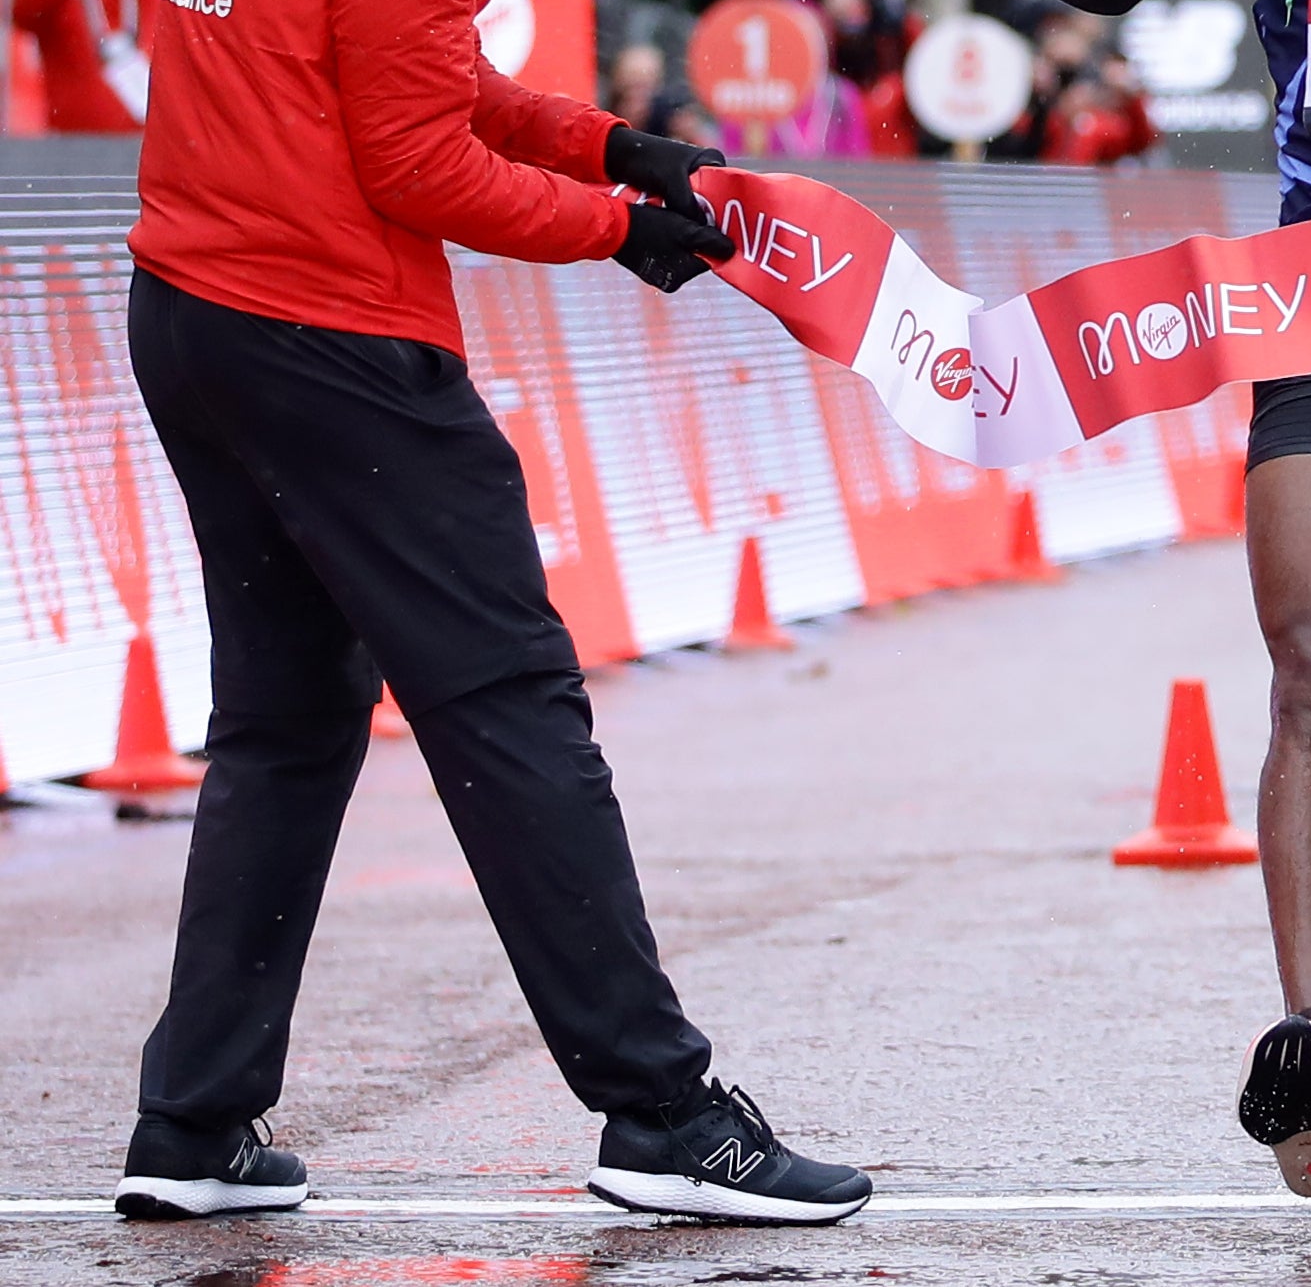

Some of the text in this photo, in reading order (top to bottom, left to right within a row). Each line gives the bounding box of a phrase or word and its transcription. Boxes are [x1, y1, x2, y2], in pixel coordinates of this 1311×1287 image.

[733, 15, 770, 76] 1
[694, 193, 853, 292] NEY
[1077, 274, 1307, 381] MONEY
[1142, 312, 1182, 351] Virgin
